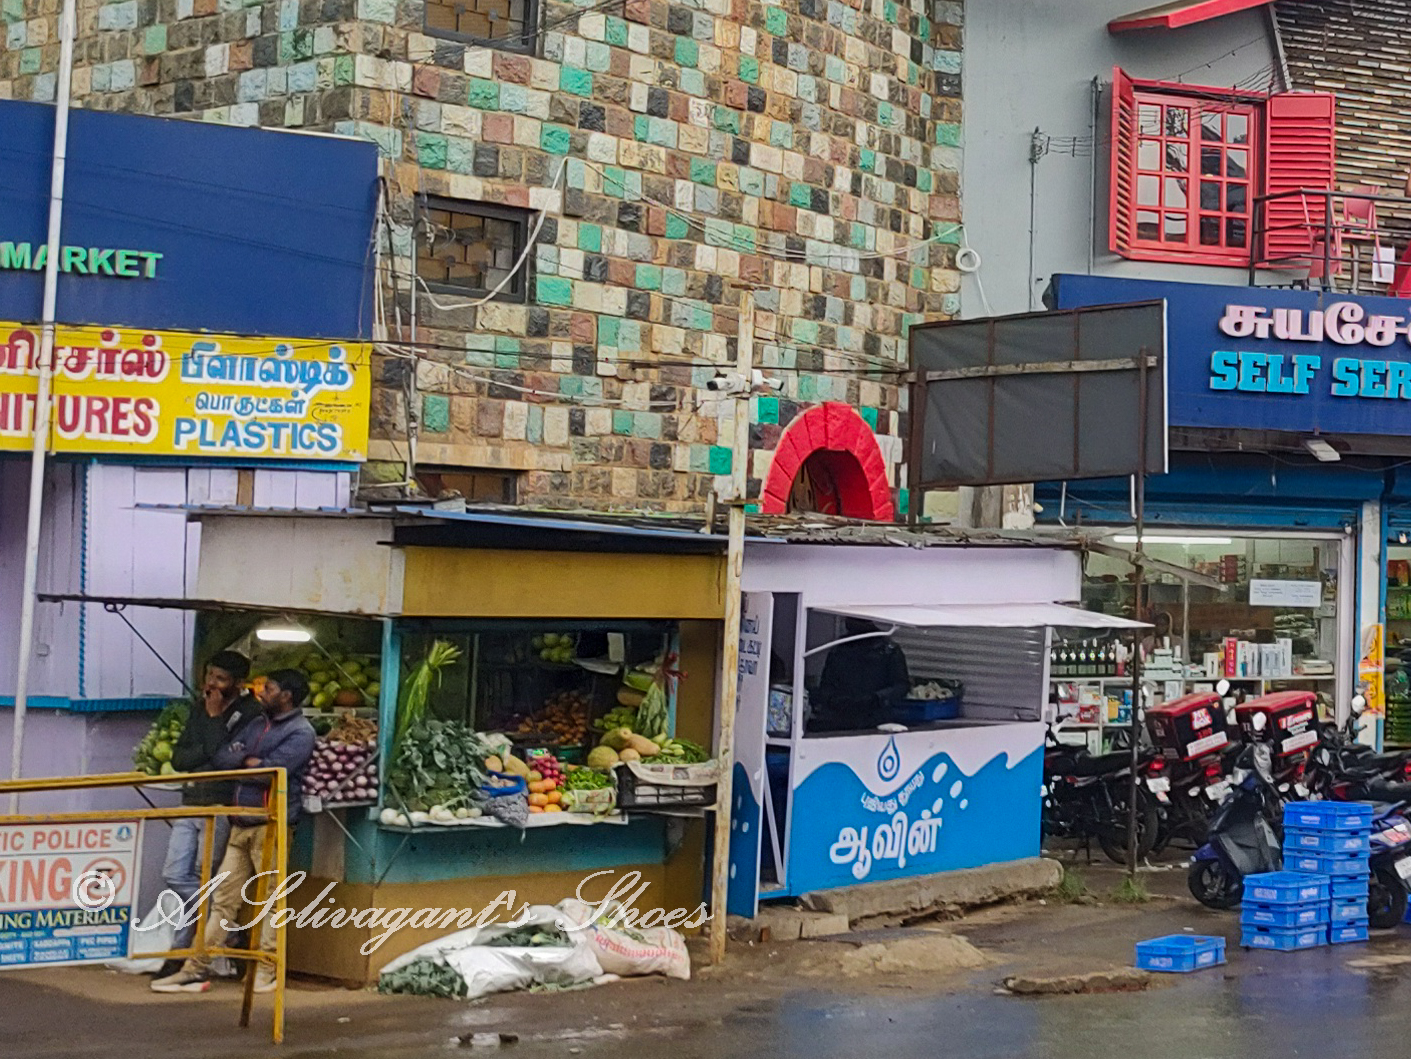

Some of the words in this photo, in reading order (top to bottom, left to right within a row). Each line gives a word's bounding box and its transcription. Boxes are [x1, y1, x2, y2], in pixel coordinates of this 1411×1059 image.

[0, 241, 163, 278] MARKET
[1210, 351, 1321, 394] SELF
[195, 389, 306, 415] பொருட்கள்
[174, 418, 339, 450] PLASTICS
[32, 828, 113, 850] POLICE
[829, 809, 942, 880] ஆவின்
[35, 907, 128, 928] MATERIALS
